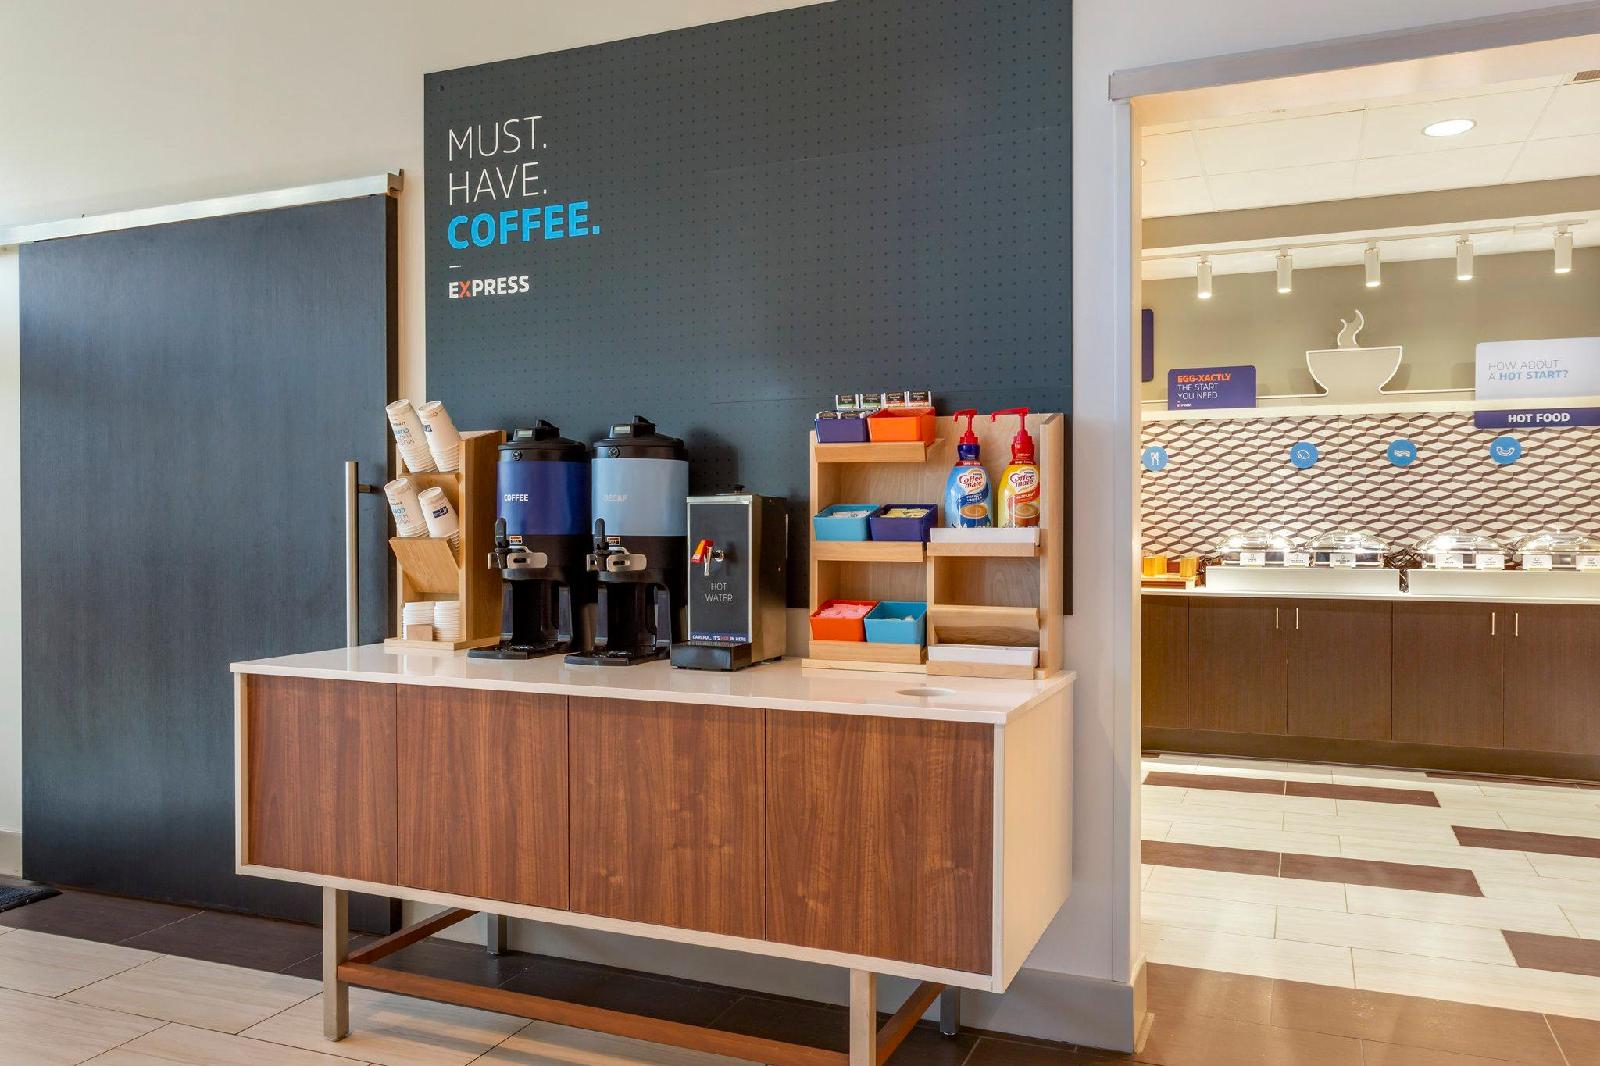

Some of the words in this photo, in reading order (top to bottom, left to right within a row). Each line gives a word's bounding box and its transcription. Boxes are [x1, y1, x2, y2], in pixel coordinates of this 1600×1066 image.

[449, 115, 547, 161] MUST.
[449, 161, 547, 205] HAVE.
[447, 201, 600, 249] COFFEE.
[448, 275, 530, 299] EXPRESS
[1488, 361, 1517, 371] HOW
[1520, 359, 1560, 370] ABOUT
[1177, 372, 1231, 383] EGG-XACTLY
[1488, 373, 1496, 381] A
[1499, 371, 1521, 381] HOT
[1526, 369, 1569, 380] START?
[1194, 382, 1219, 391] START
[1177, 392, 1195, 400] YOU
[1196, 391, 1218, 399] NEED
[1508, 414, 1533, 423] HOT
[1536, 412, 1571, 423] FOOD
[504, 493, 529, 502] COFFEE
[711, 582, 728, 591] HOT
[704, 593, 733, 602] WATER
